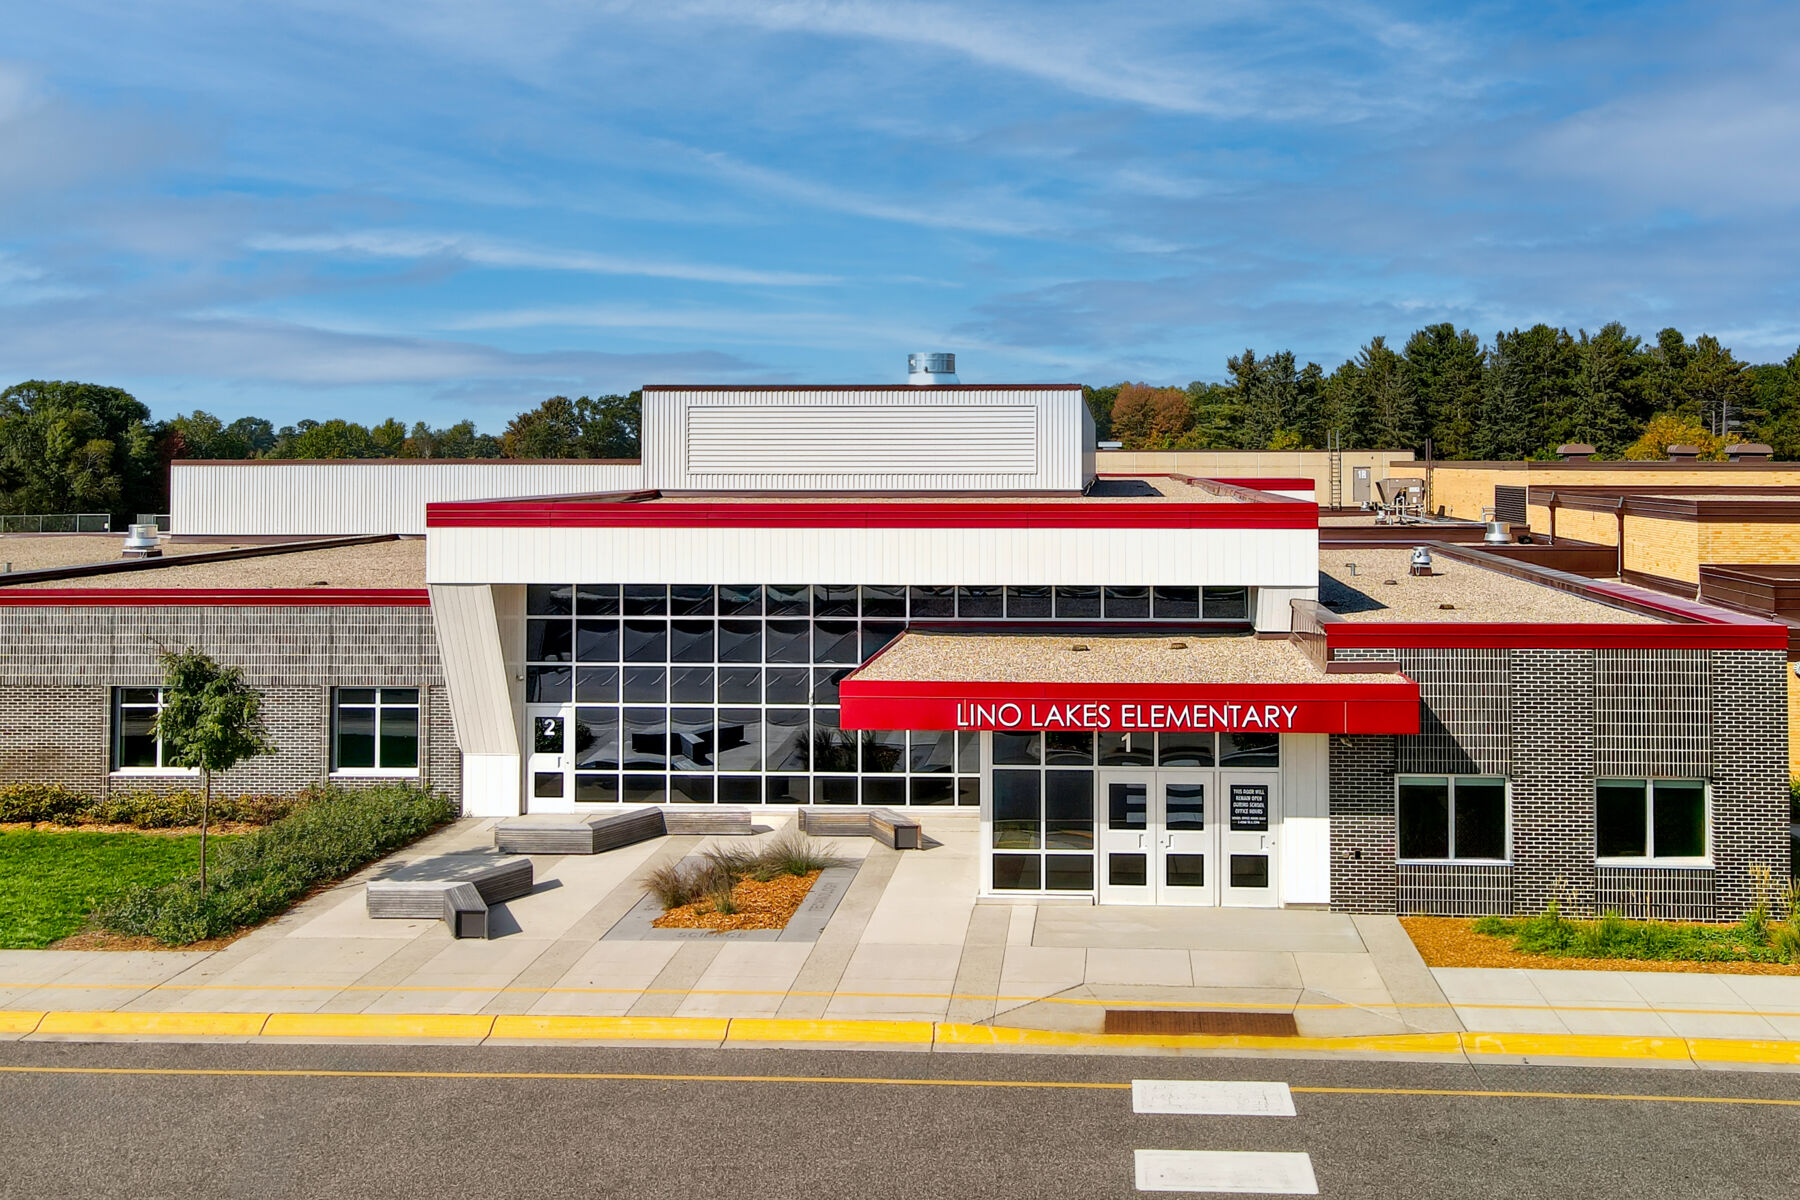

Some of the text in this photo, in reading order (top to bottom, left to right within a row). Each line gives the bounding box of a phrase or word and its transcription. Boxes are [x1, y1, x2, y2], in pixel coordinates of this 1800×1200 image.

[957, 702, 1298, 729] LINO LAKES ELEMENTARY
[543, 718, 556, 736] 2
[1120, 732, 1132, 753] 1
